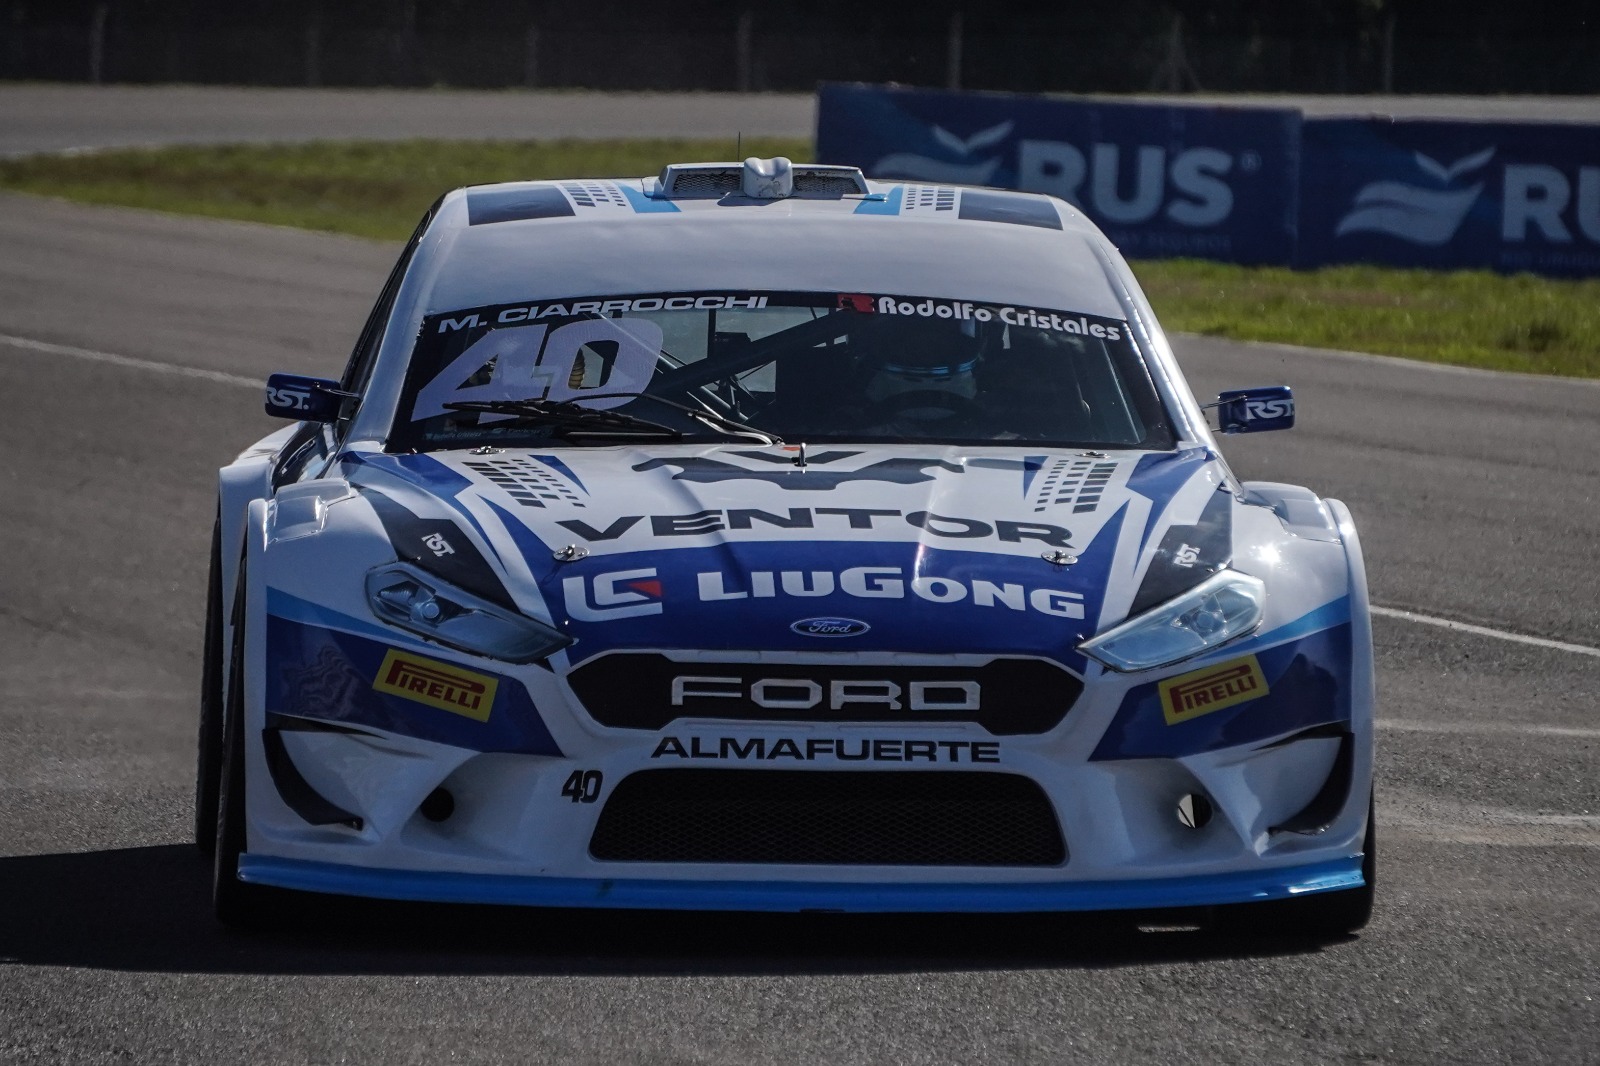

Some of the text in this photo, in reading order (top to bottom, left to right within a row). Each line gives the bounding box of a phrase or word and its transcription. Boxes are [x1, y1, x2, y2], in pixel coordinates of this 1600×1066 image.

[438, 296, 769, 334] M. CIARROCCHI
[879, 296, 992, 323] Rodolfo
[999, 307, 1121, 340] Cristales
[411, 319, 664, 424] 40
[556, 506, 1074, 547] VENTOR
[808, 620, 851, 633] Ford
[384, 659, 486, 710] PIRELLI
[671, 677, 983, 711] FORD
[1169, 664, 1257, 714] PIRELLI
[651, 736, 1000, 763] ALMAFUERTE
[562, 769, 603, 804] 40
